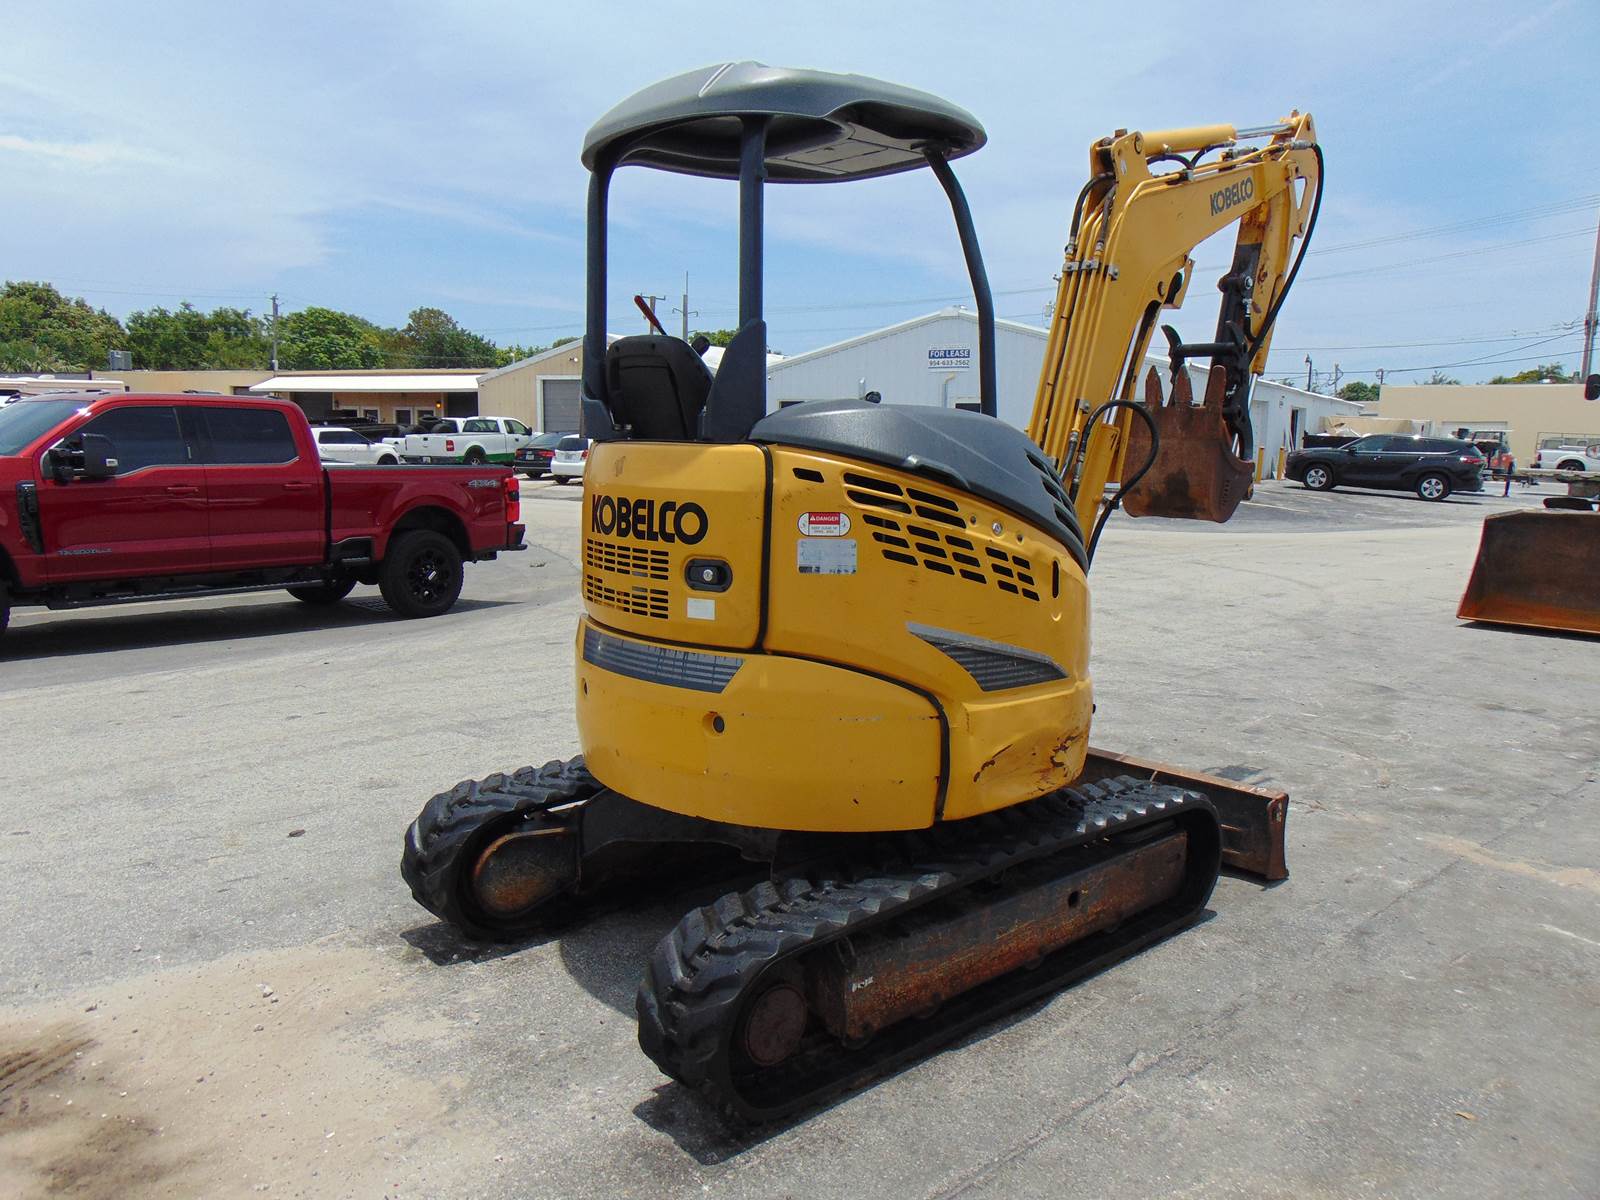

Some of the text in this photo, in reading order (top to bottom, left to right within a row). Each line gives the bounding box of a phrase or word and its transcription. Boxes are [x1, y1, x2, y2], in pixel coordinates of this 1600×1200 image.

[1209, 176, 1254, 217] KOBELCO
[930, 350, 969, 358] FOR LEASE
[591, 494, 709, 545] KOBELCO
